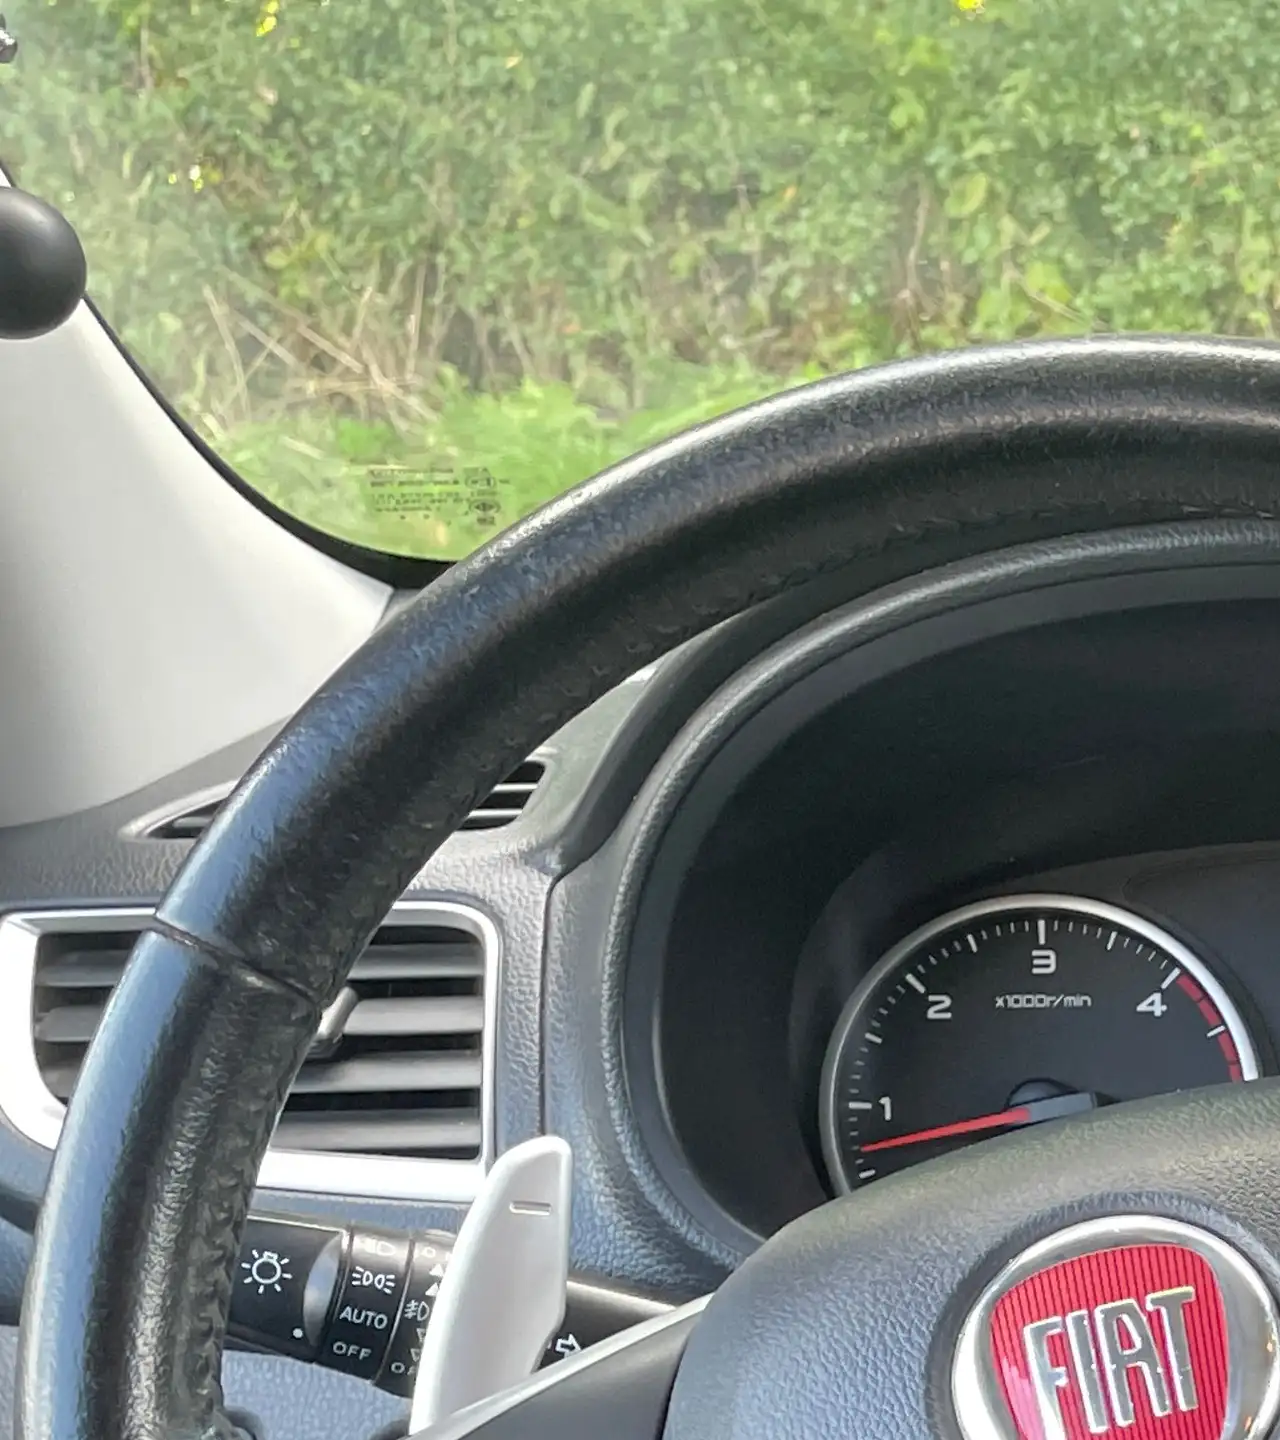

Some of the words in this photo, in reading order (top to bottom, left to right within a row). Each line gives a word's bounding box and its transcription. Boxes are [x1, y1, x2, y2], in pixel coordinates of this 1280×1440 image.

[1032, 949, 1056, 974] 3
[926, 995, 953, 1020] 2
[1136, 993, 1168, 1017] 4
[879, 1096, 892, 1120] 1
[339, 1305, 388, 1330] AUTO
[333, 1341, 372, 1360] OFF
